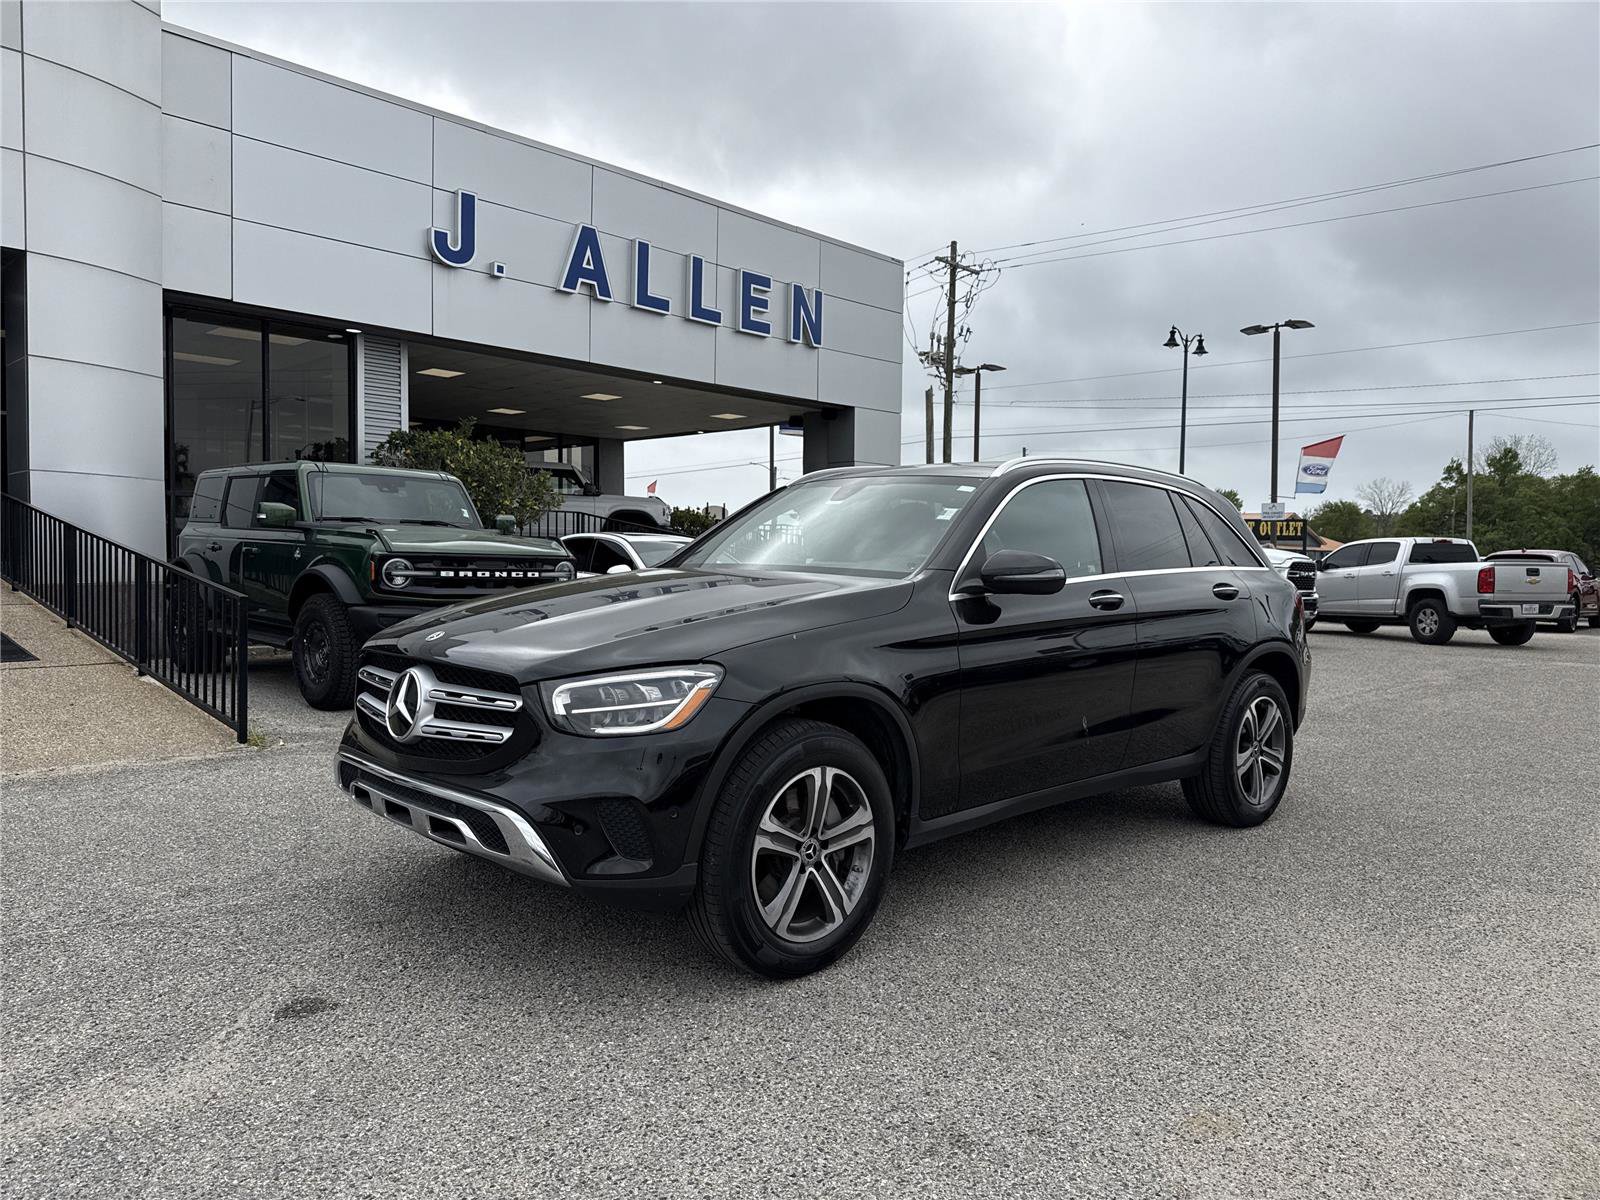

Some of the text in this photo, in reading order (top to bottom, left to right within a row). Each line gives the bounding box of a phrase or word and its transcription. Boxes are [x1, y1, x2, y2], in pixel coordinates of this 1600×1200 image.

[427, 188, 824, 348] J. ALLEN
[1306, 464, 1328, 475] Ford
